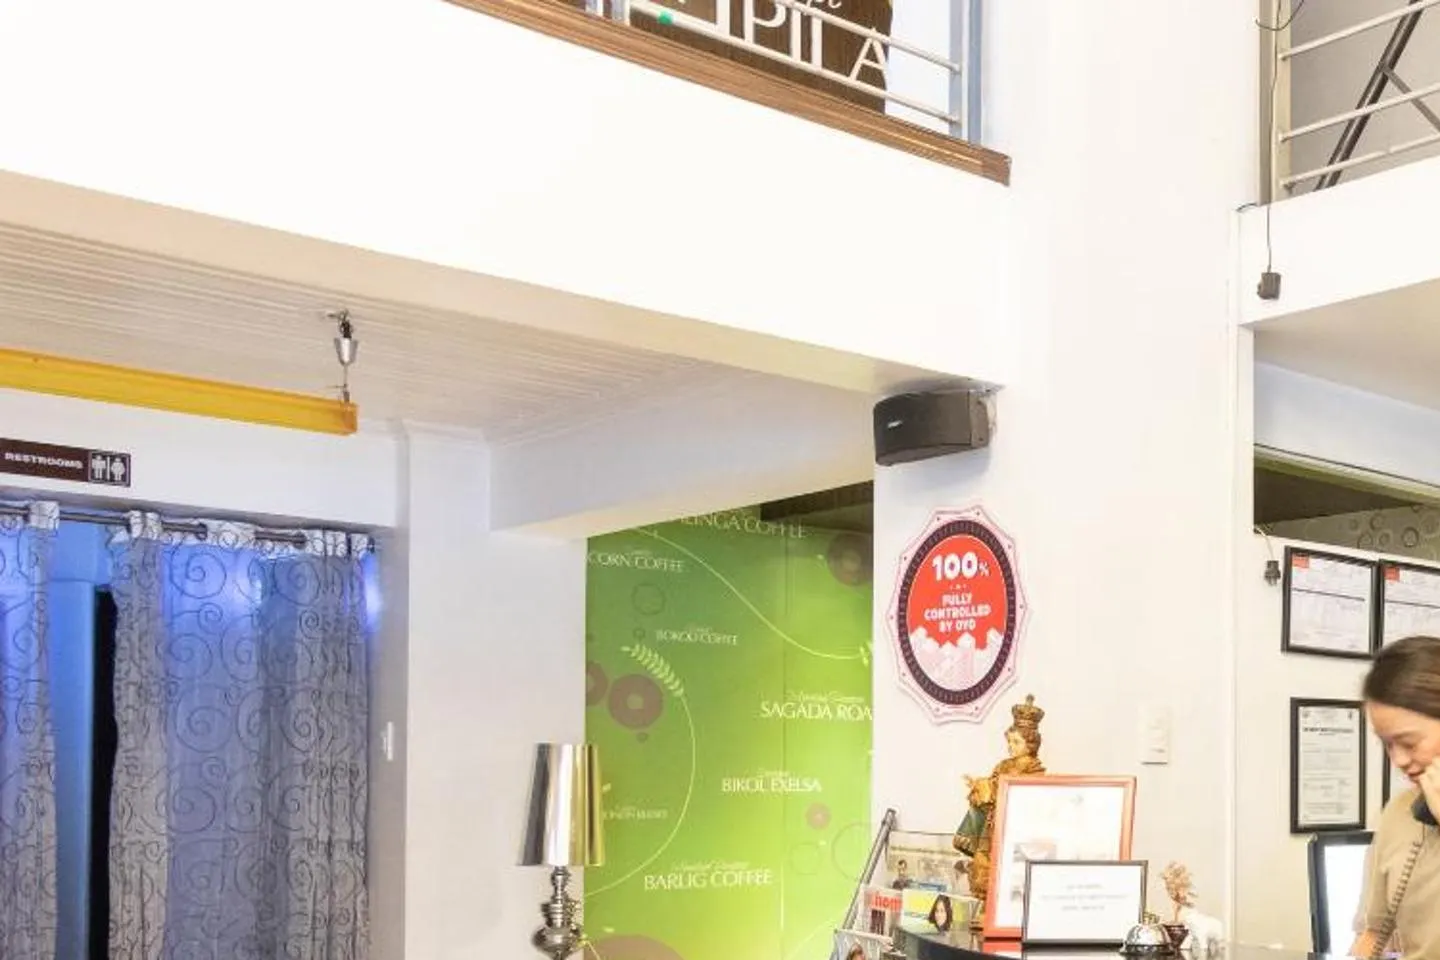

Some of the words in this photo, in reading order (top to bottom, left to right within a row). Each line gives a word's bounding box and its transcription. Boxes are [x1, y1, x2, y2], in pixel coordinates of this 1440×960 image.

[4, 452, 84, 469] RESTROOMS
[634, 555, 684, 573] COFFEE
[941, 592, 973, 605] FULLY
[923, 604, 992, 621] CONTROLLED
[939, 619, 953, 633] BY
[955, 618, 977, 632] OYO
[761, 700, 832, 721] SAGADA
[721, 778, 764, 793] BIKOL
[644, 872, 707, 891] BARLIG
[710, 868, 773, 887] COFFEE
